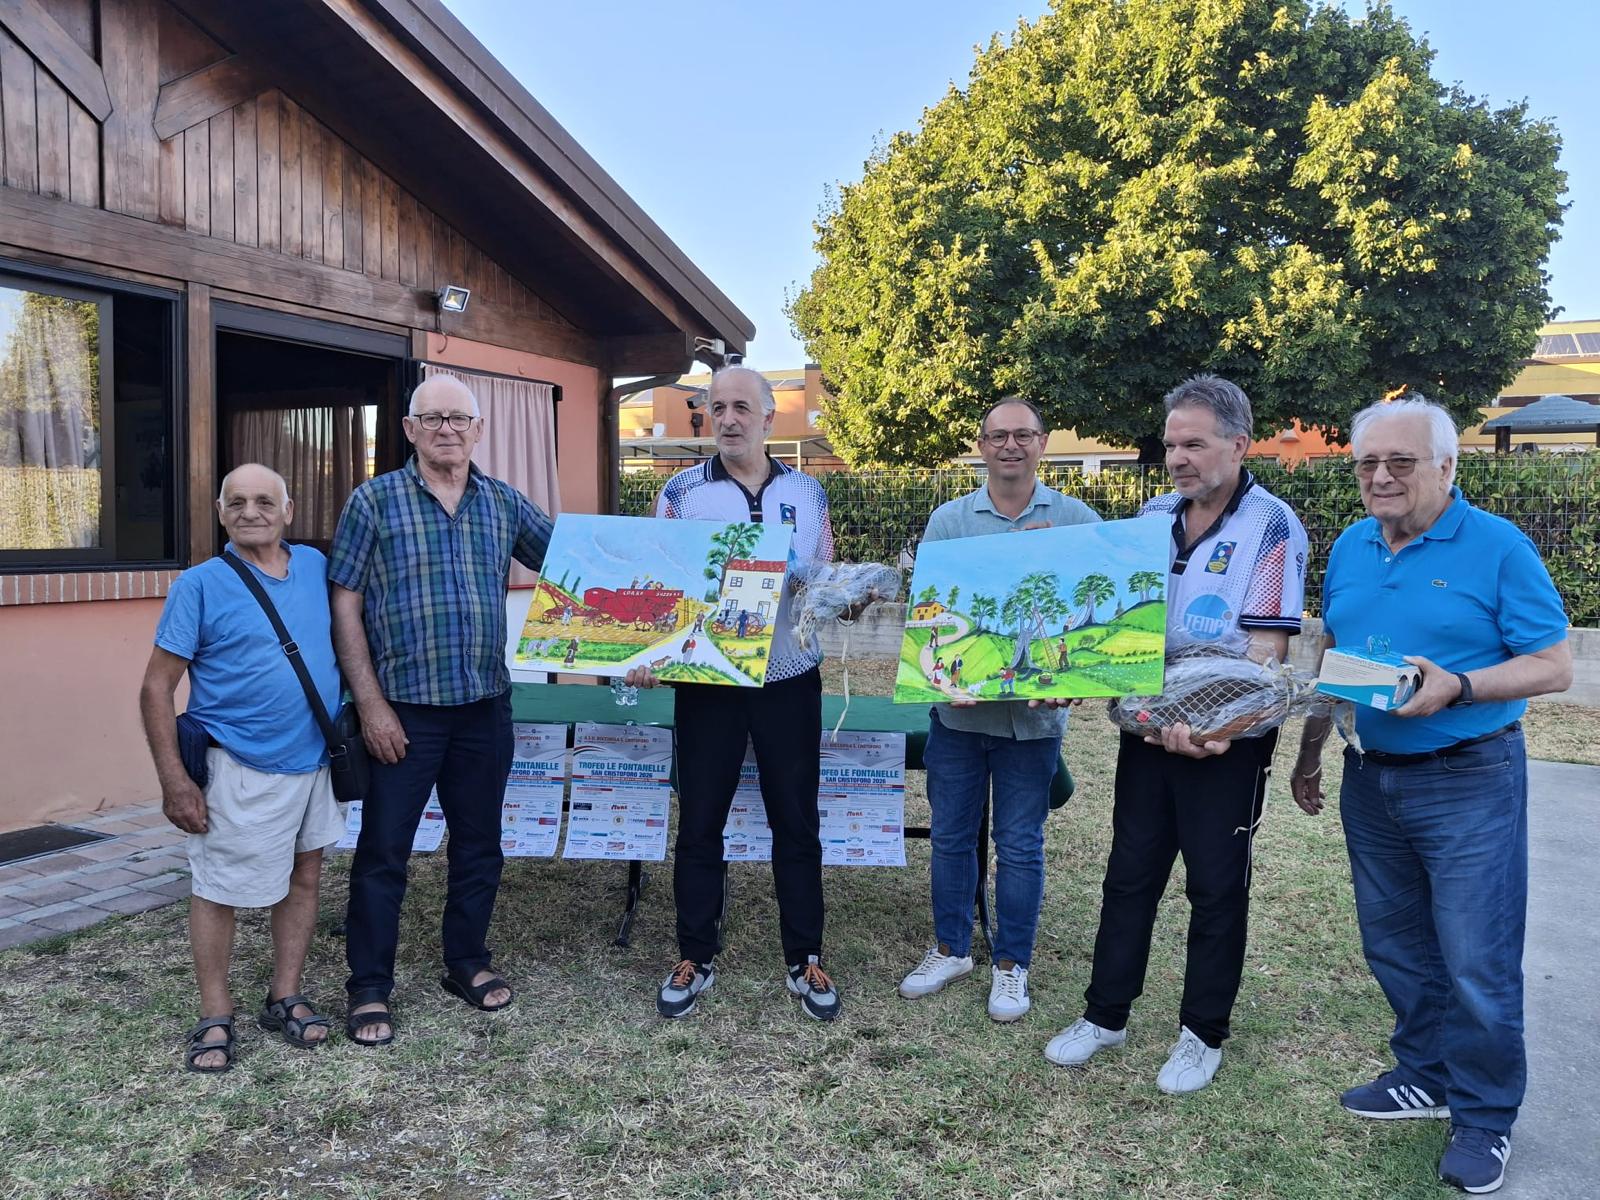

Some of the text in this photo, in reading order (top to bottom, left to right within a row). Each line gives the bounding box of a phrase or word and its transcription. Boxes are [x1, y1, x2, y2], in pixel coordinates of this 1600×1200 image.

[579, 761, 666, 772] TROFEO LE FONTANELLE
[821, 768, 900, 778] OFEO LE FONTANELLE
